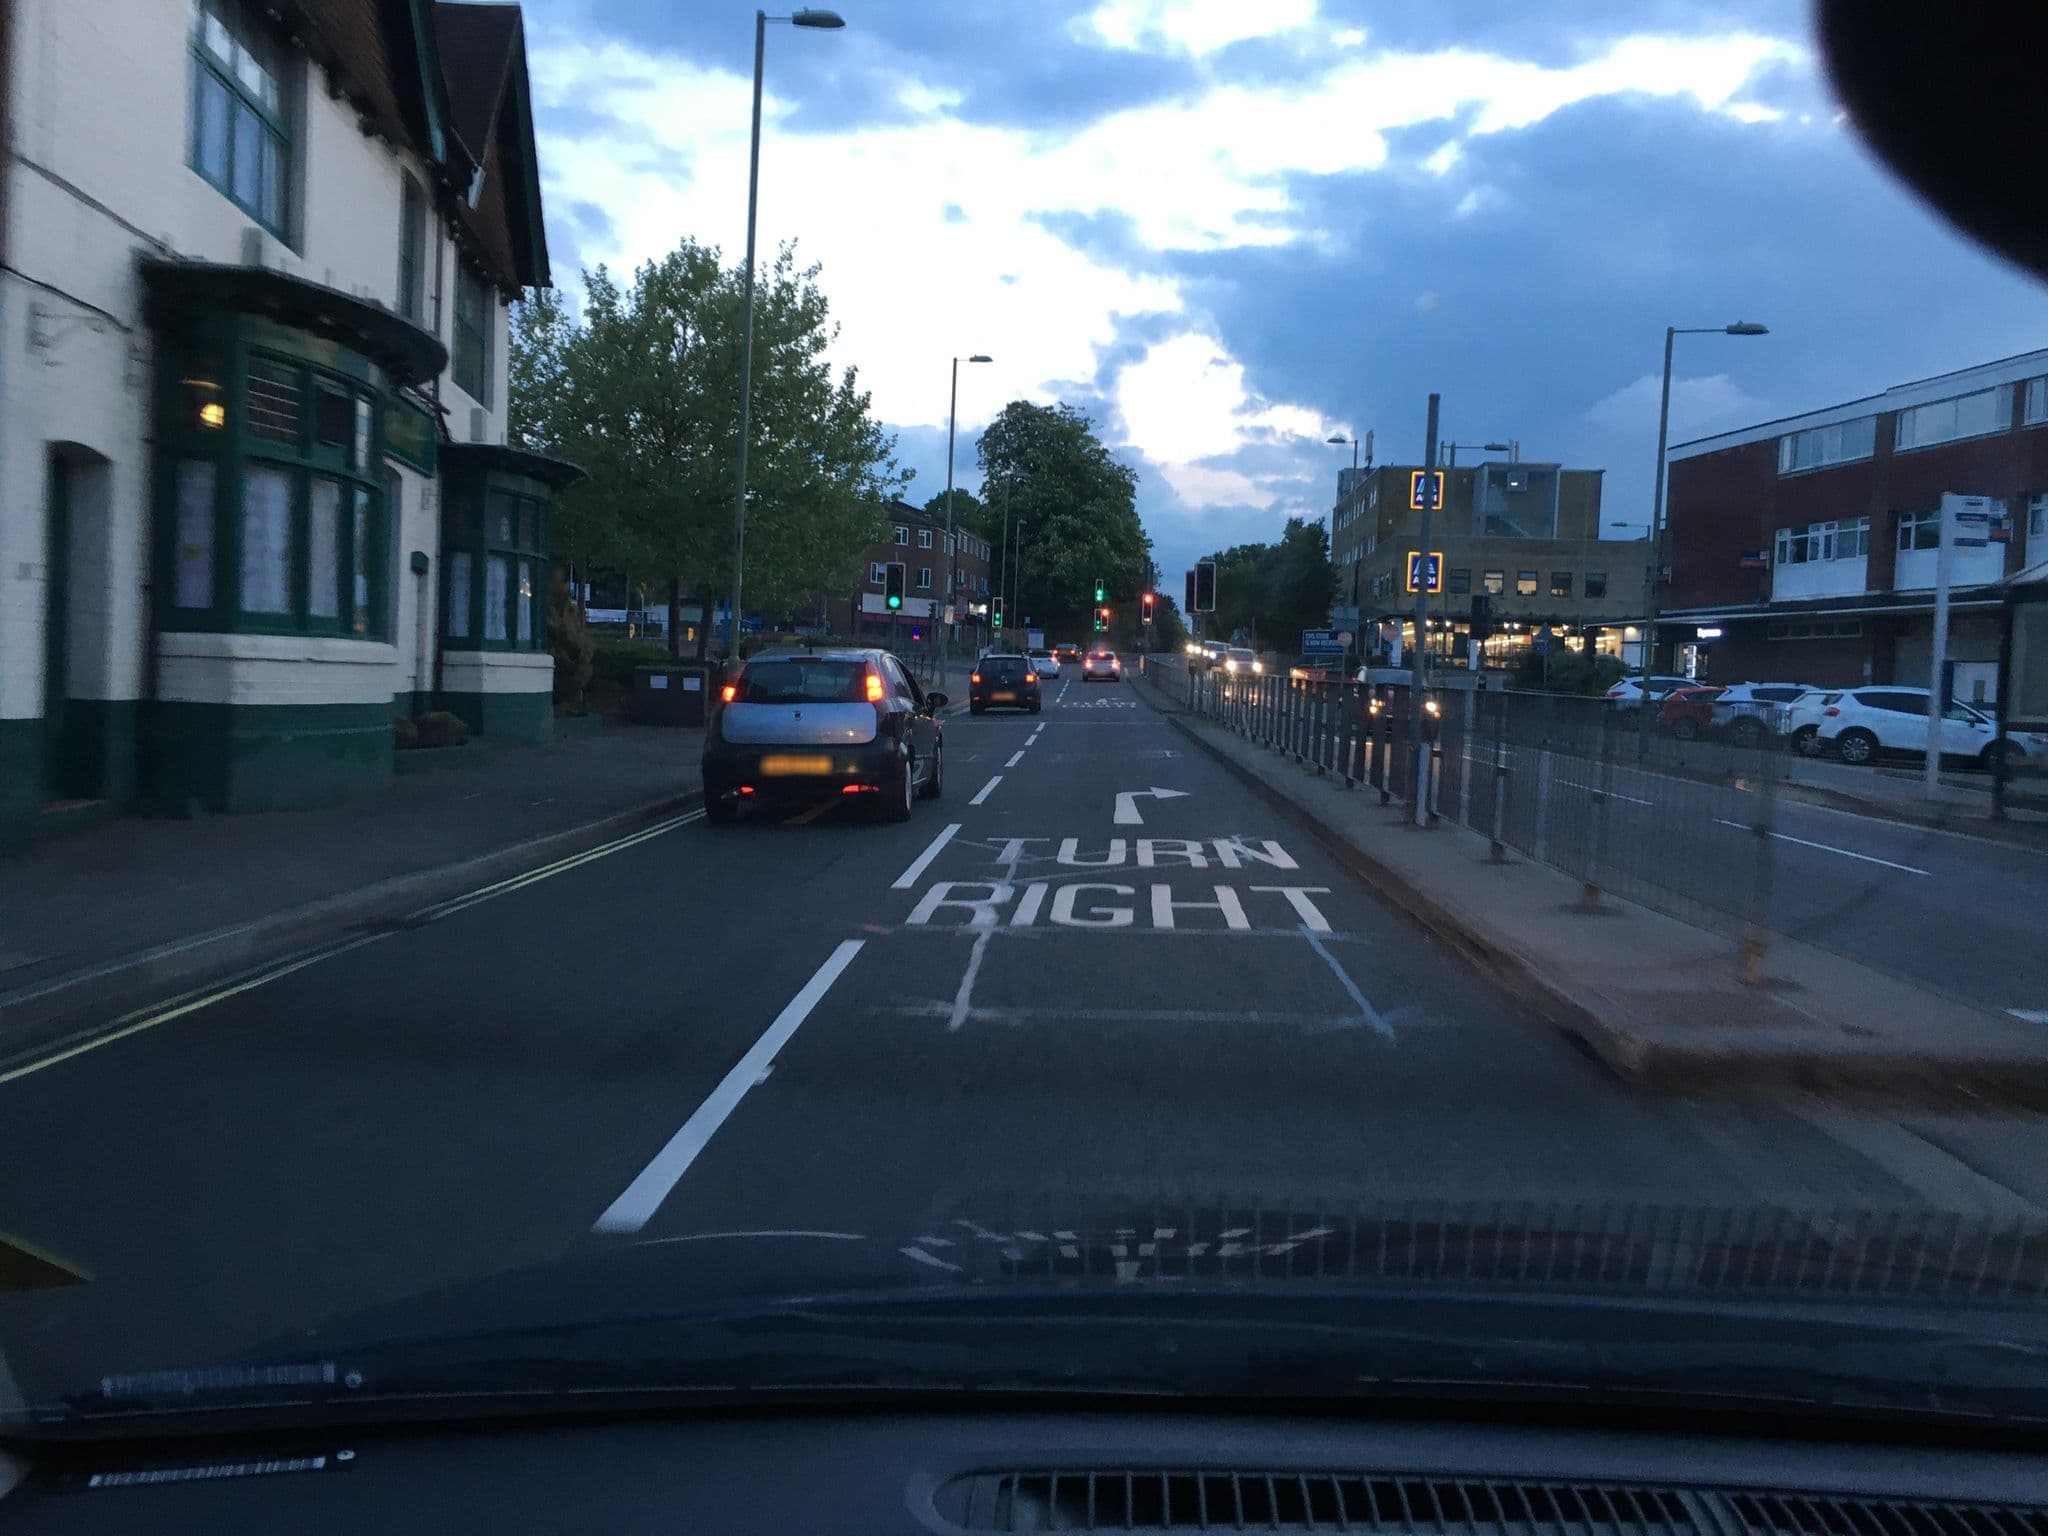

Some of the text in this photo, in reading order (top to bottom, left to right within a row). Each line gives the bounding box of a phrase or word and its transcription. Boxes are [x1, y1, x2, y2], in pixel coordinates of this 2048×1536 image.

[1416, 494, 1437, 502] AI
[1412, 576, 1437, 585] ADI
[987, 837, 1299, 868] TURN
[906, 882, 1331, 931] RIGHT
